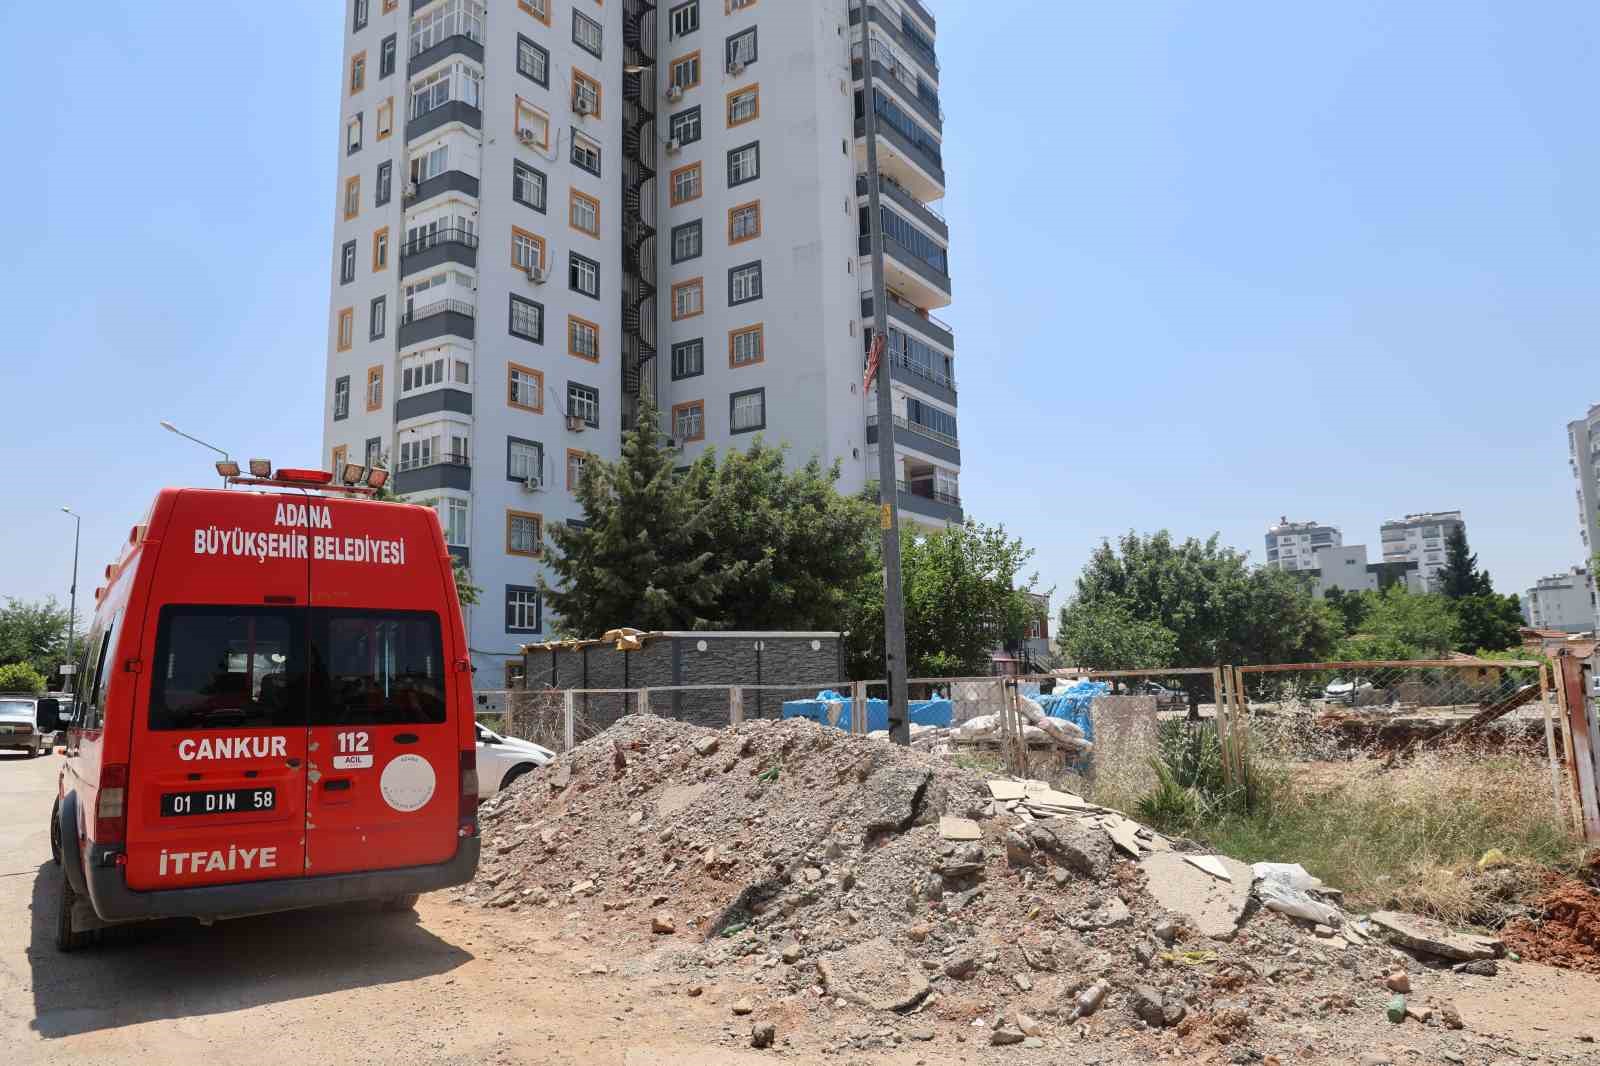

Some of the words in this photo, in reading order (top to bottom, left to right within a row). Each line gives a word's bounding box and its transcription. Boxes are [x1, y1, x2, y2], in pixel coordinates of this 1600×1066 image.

[274, 503, 332, 529] ADANA
[194, 526, 308, 563] BÜYÜKŞEHİR
[313, 534, 405, 565] BELEDİYESİ
[178, 736, 287, 760] CANKUR
[337, 732, 369, 752] 112
[174, 795, 191, 813] 01
[206, 793, 236, 811] DIN
[253, 791, 273, 808] 58
[159, 844, 277, 876] İTFAİYE
